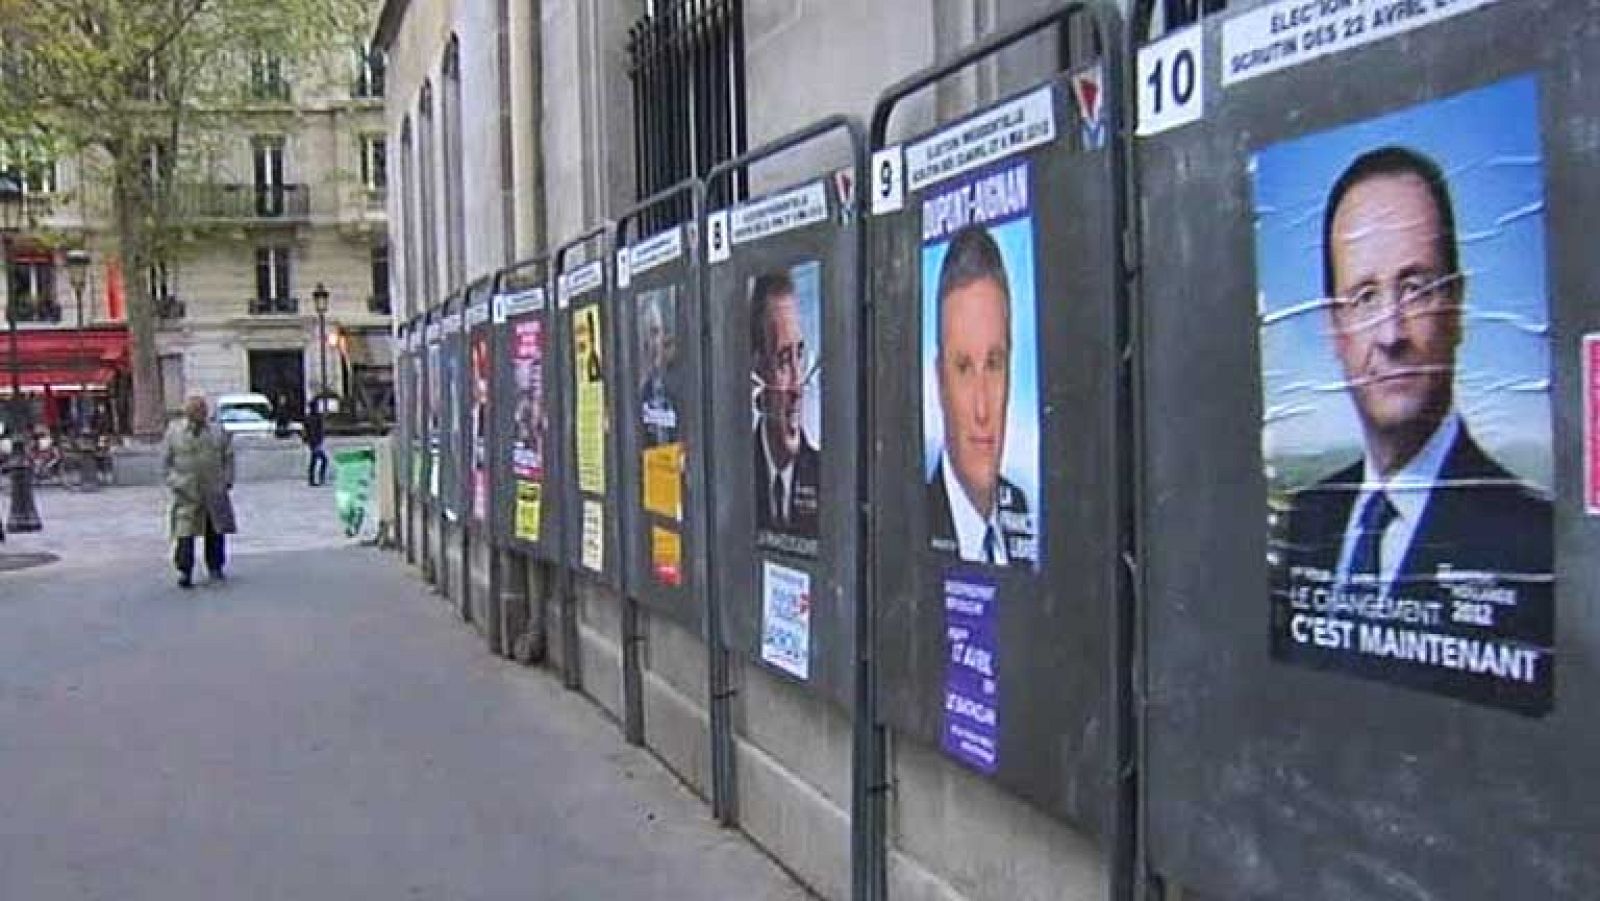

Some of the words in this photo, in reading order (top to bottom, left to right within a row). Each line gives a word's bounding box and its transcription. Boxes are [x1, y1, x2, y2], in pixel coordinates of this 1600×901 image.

[1147, 50, 1195, 114] 10
[879, 159, 893, 198] 9
[1290, 613, 1355, 649] C'EST
[1359, 622, 1541, 683] MAINTENANT
